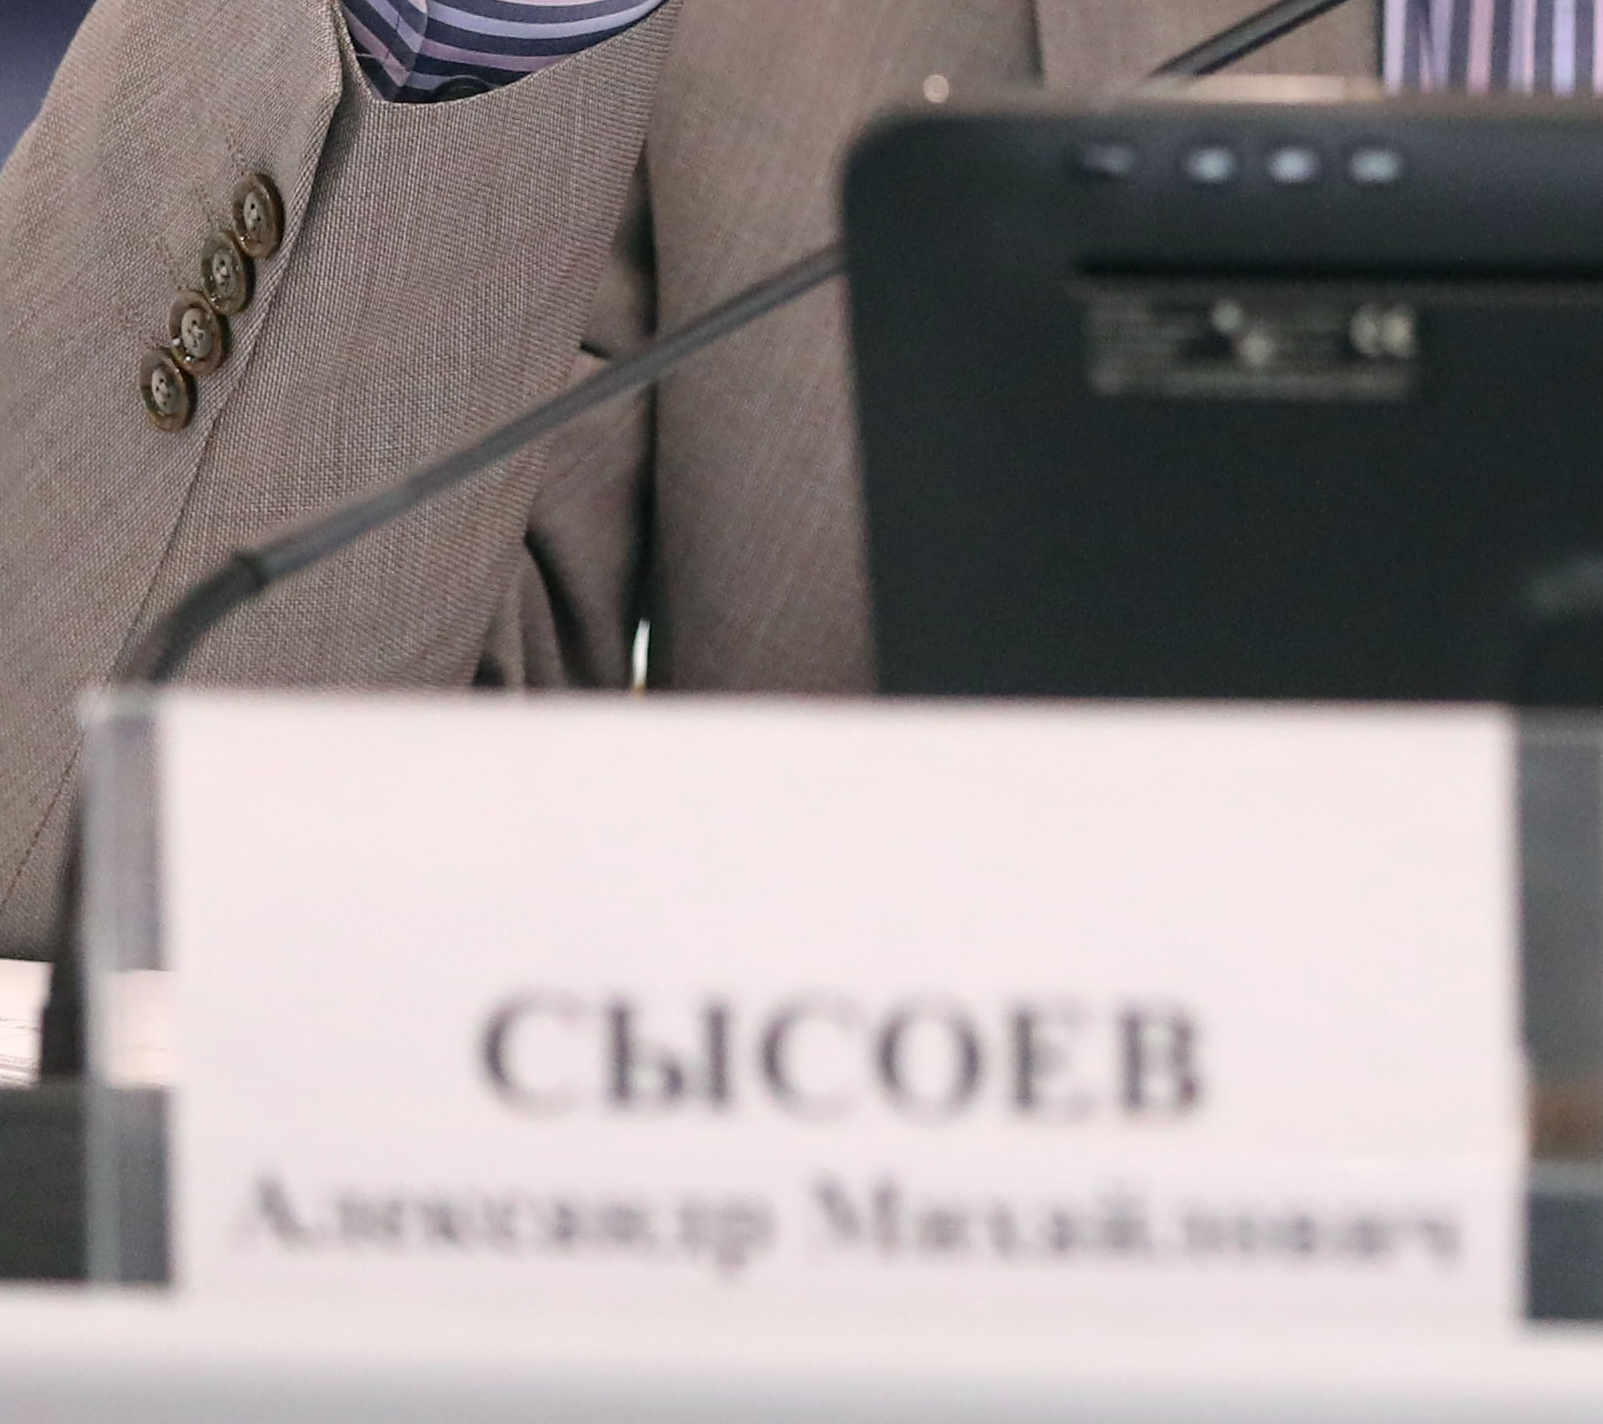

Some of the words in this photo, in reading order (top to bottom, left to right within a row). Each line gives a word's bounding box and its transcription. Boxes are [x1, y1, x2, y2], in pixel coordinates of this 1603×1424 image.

[478, 994, 1202, 1118] СЫСОЕВ
[236, 1168, 775, 1277] Александр
[810, 1169, 1461, 1271] Михайлович
